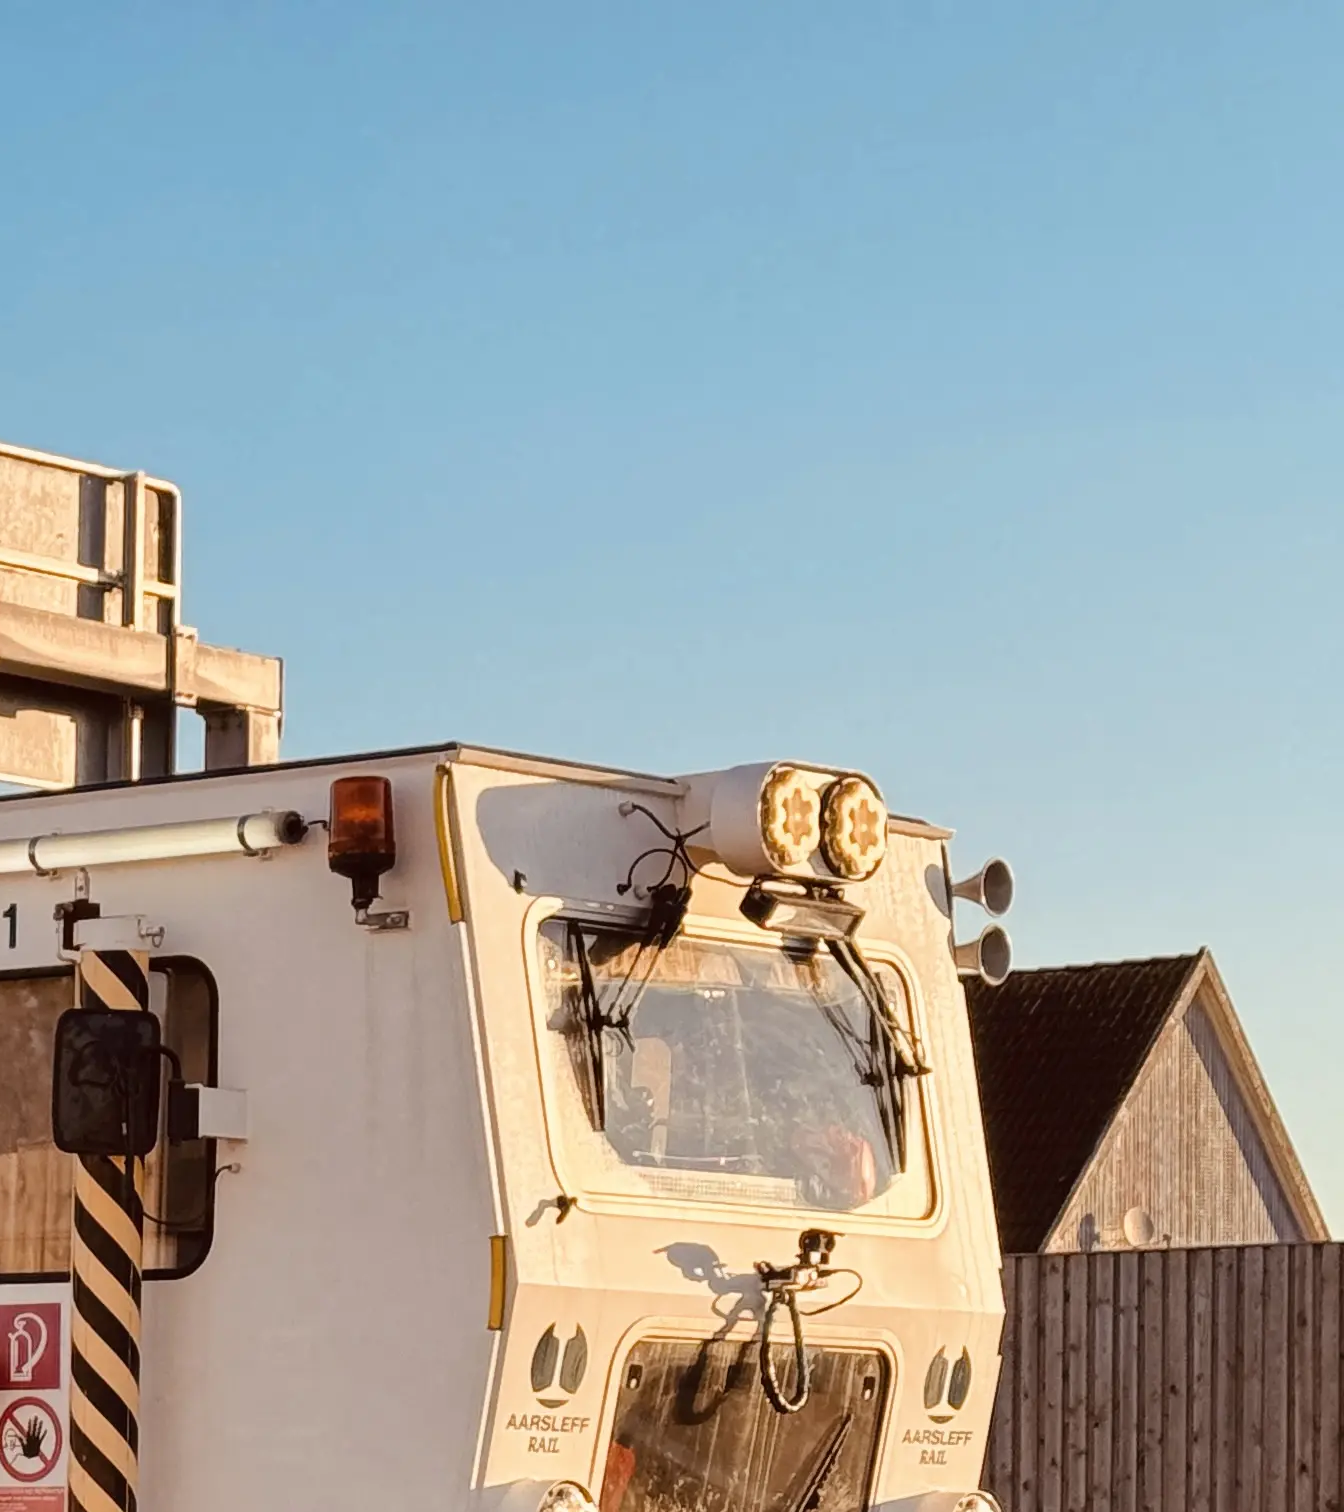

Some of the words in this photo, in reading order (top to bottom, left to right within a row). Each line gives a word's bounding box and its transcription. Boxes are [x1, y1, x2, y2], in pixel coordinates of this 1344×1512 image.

[2, 903, 17, 950] 1
[505, 1413, 591, 1434] AARSLEFF
[527, 1436, 561, 1454] RAIL
[901, 1428, 974, 1447] AARSLEFF
[918, 1448, 948, 1466] RAIL
